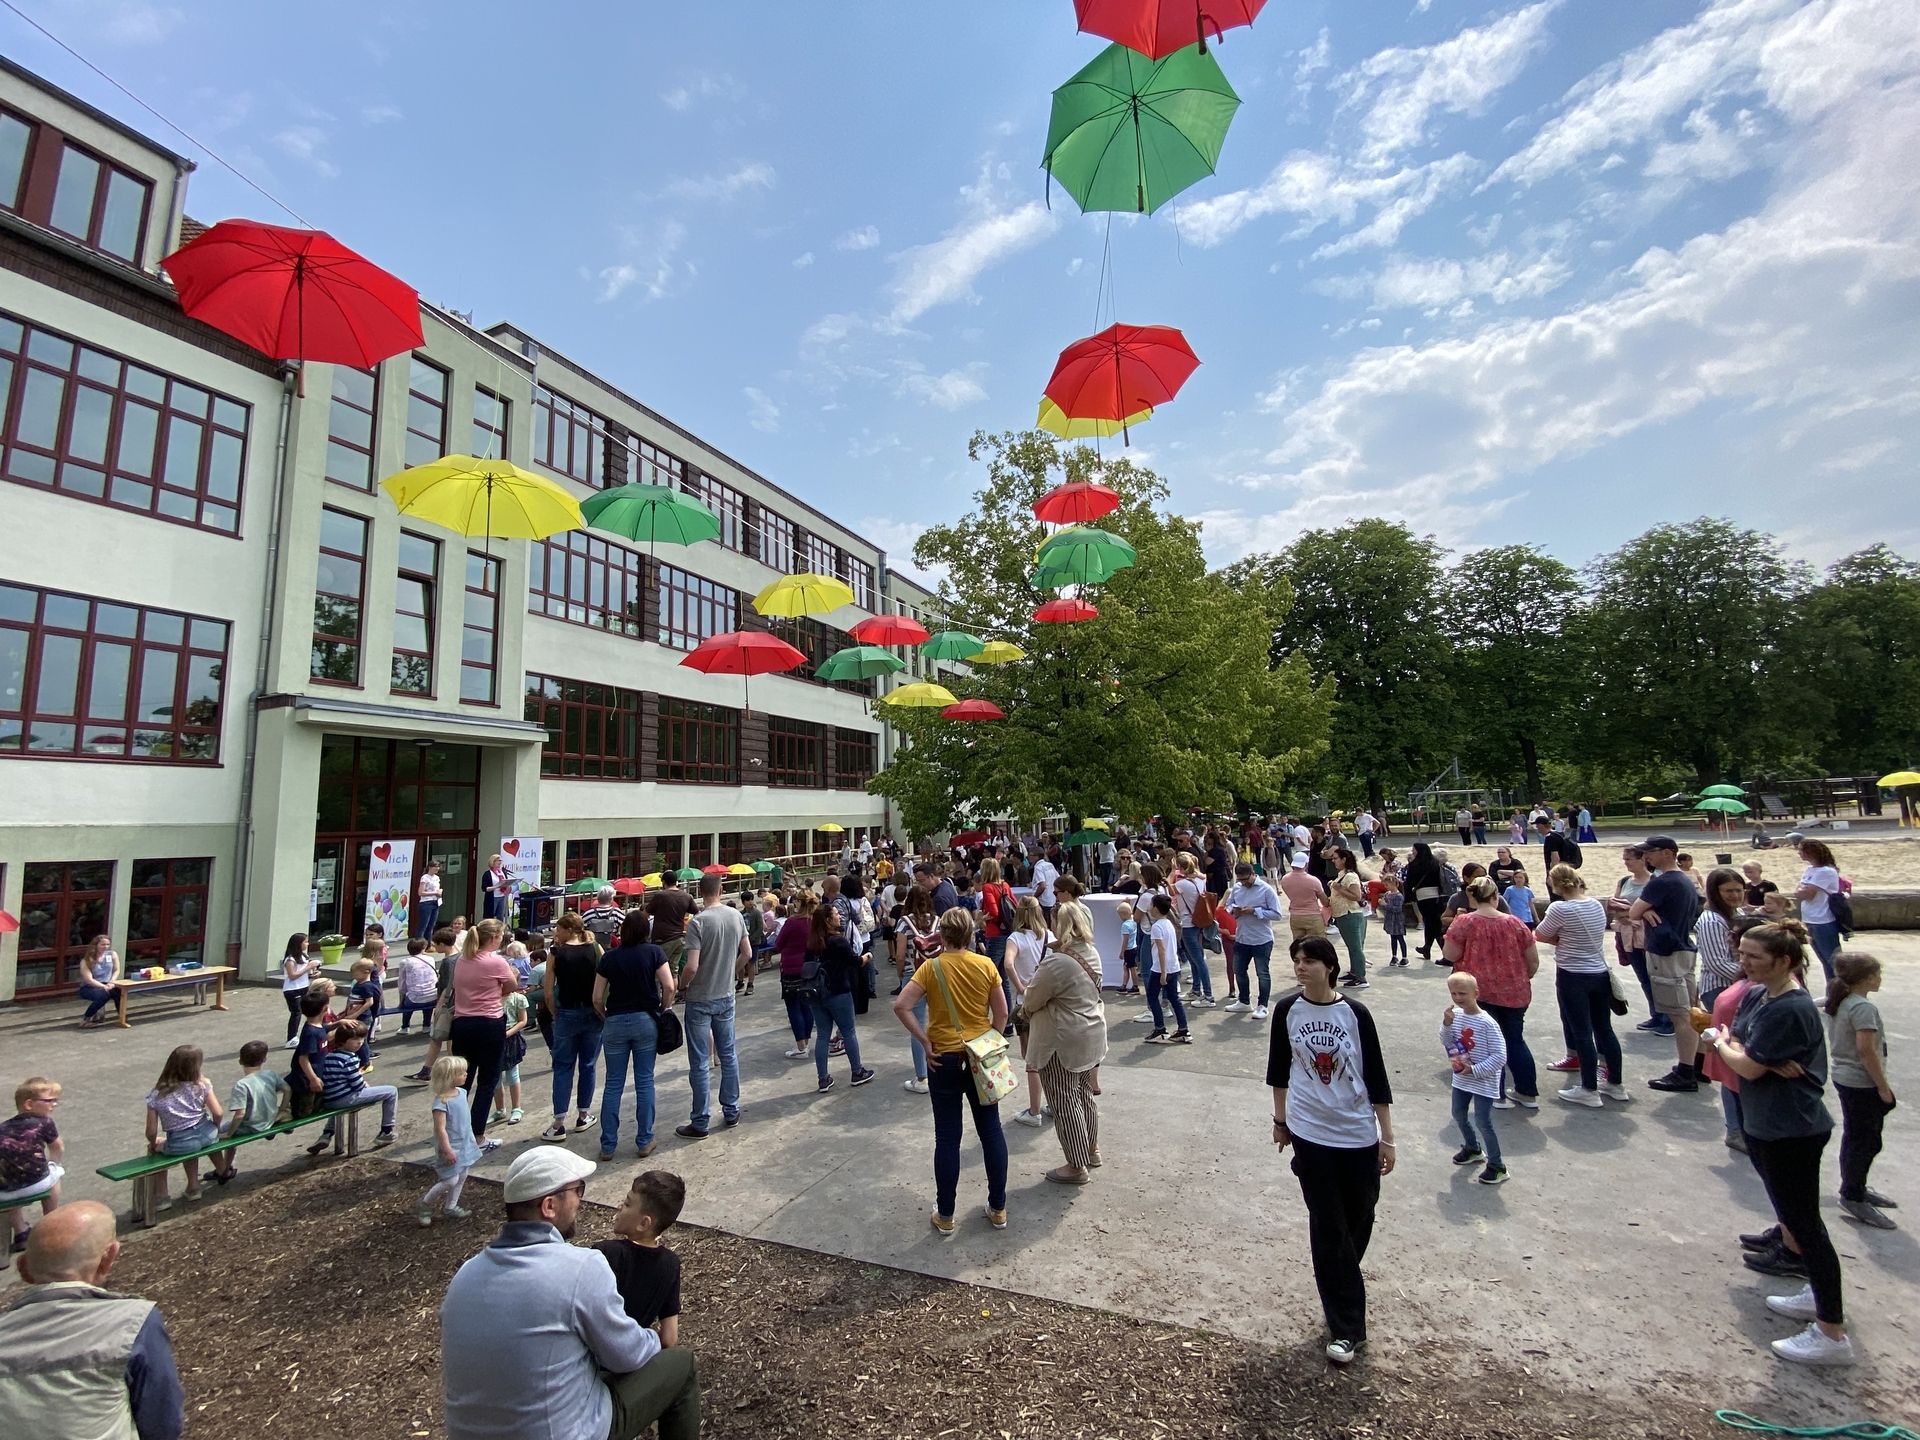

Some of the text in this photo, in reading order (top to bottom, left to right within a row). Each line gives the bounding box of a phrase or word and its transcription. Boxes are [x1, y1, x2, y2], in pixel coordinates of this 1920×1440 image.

[388, 854, 408, 864] lich
[517, 849, 537, 859] lich
[1298, 1020, 1348, 1042] HELLFIRE
[1310, 1035, 1335, 1047] CLUB
